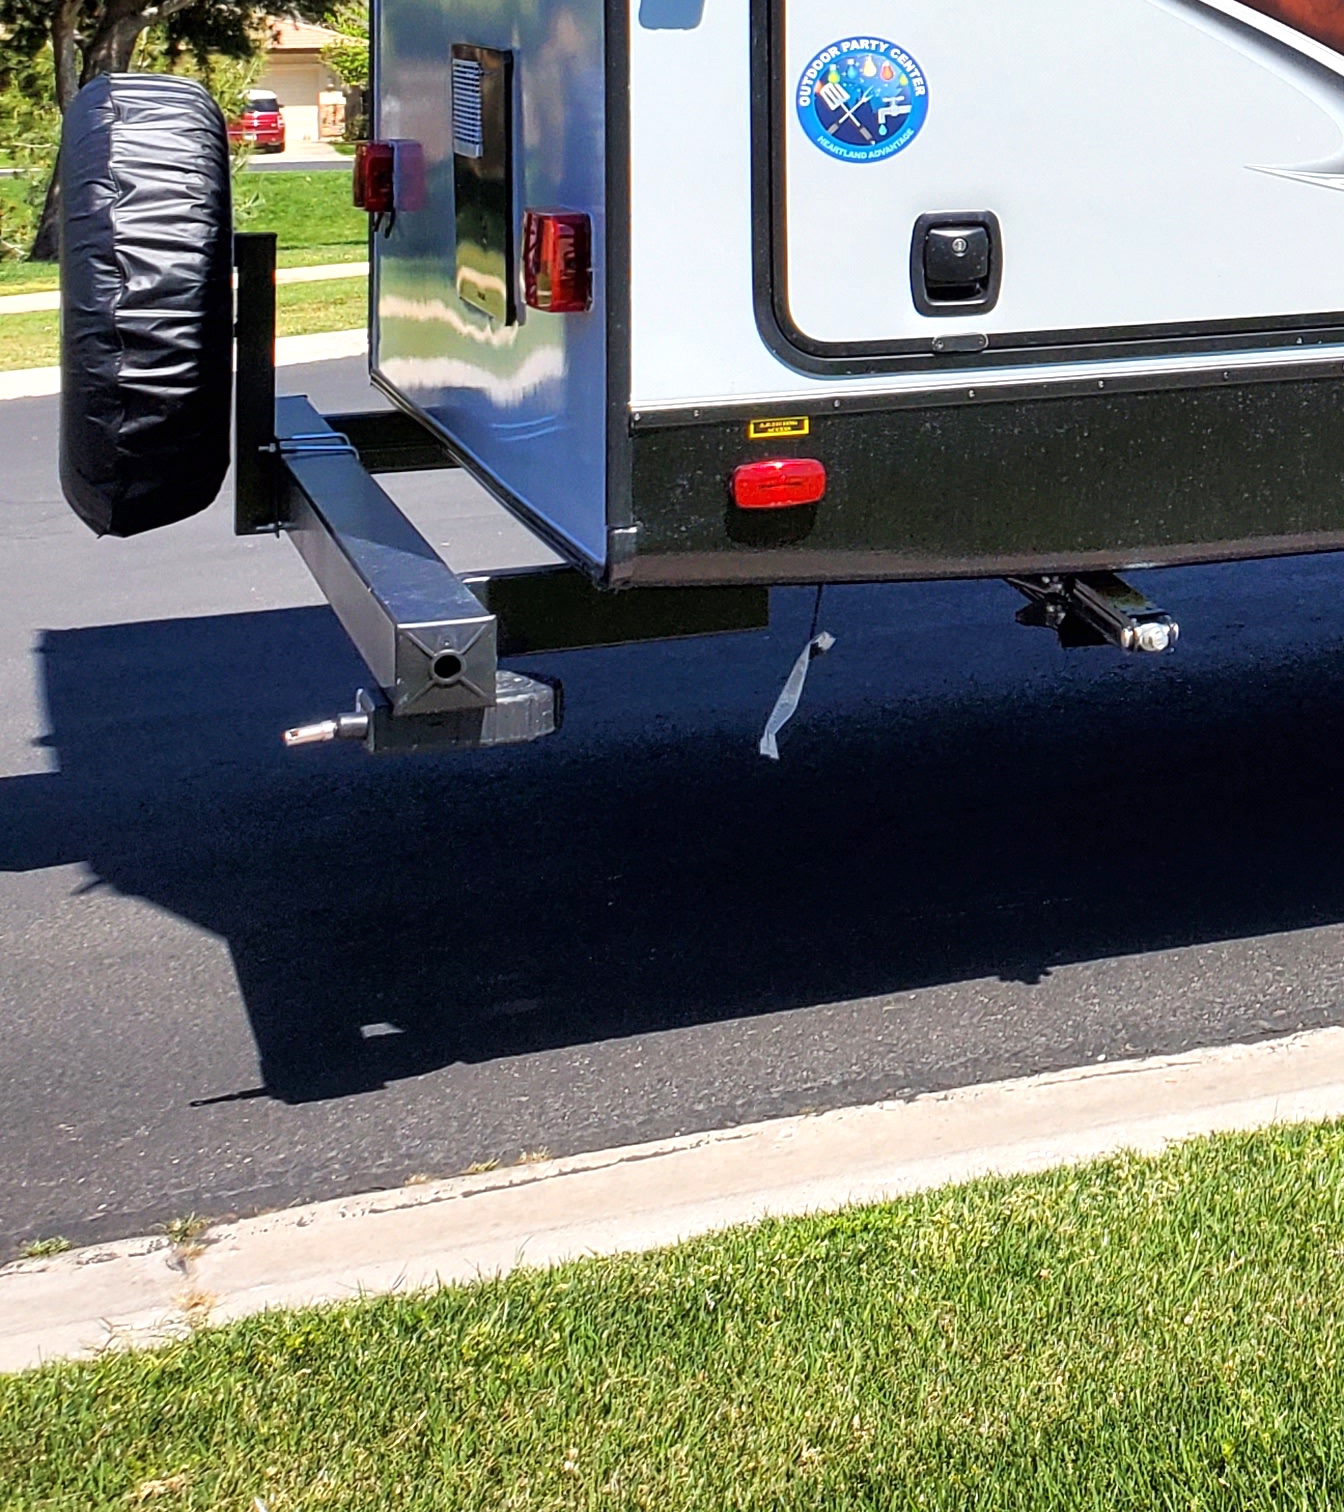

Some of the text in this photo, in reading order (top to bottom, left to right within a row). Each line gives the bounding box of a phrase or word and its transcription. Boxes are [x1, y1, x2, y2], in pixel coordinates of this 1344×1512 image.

[799, 39, 927, 107] OUTDOOR PARTY CENTER
[816, 127, 915, 159] HEARTLAND ADVANTAGE
